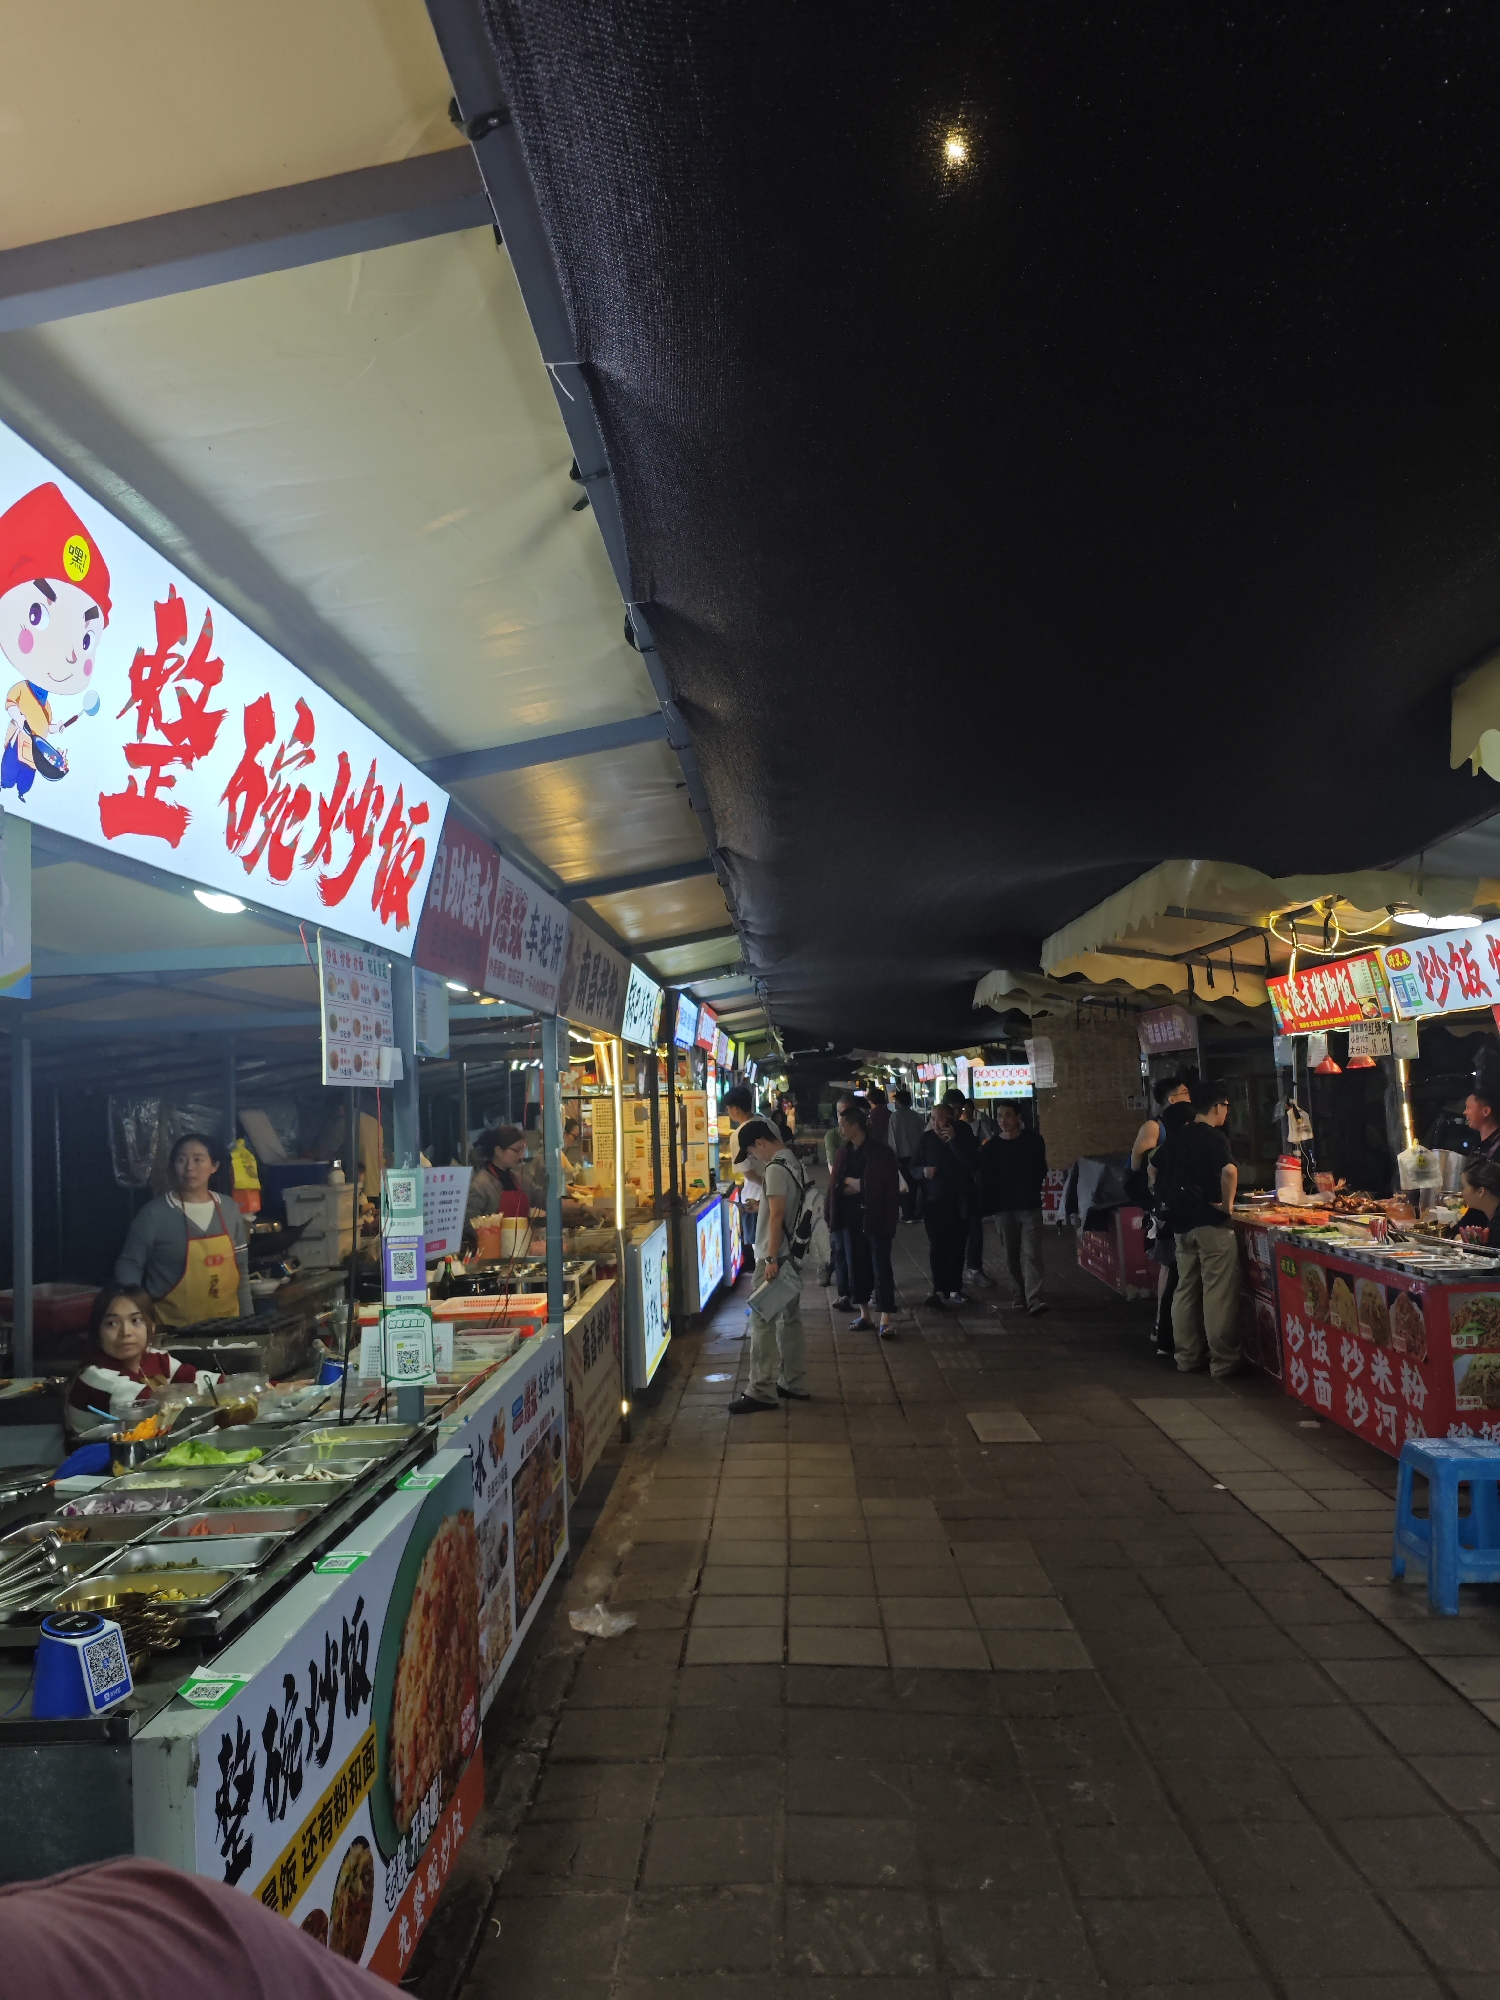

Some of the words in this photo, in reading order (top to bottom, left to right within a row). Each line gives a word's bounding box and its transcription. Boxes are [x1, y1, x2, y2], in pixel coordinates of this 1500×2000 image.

[99, 583, 430, 932] 整碗炒饭
[430, 831, 493, 936] 自助糖水
[1285, 1312, 1331, 1368] 炒饭
[1340, 1335, 1429, 1412] 炒米粉
[1289, 1355, 1333, 1411] 炒面
[1455, 1334, 1474, 1345] 炒面
[215, 1595, 372, 1887] 整碗炒饭
[302, 1738, 377, 1881] 还有粉和面
